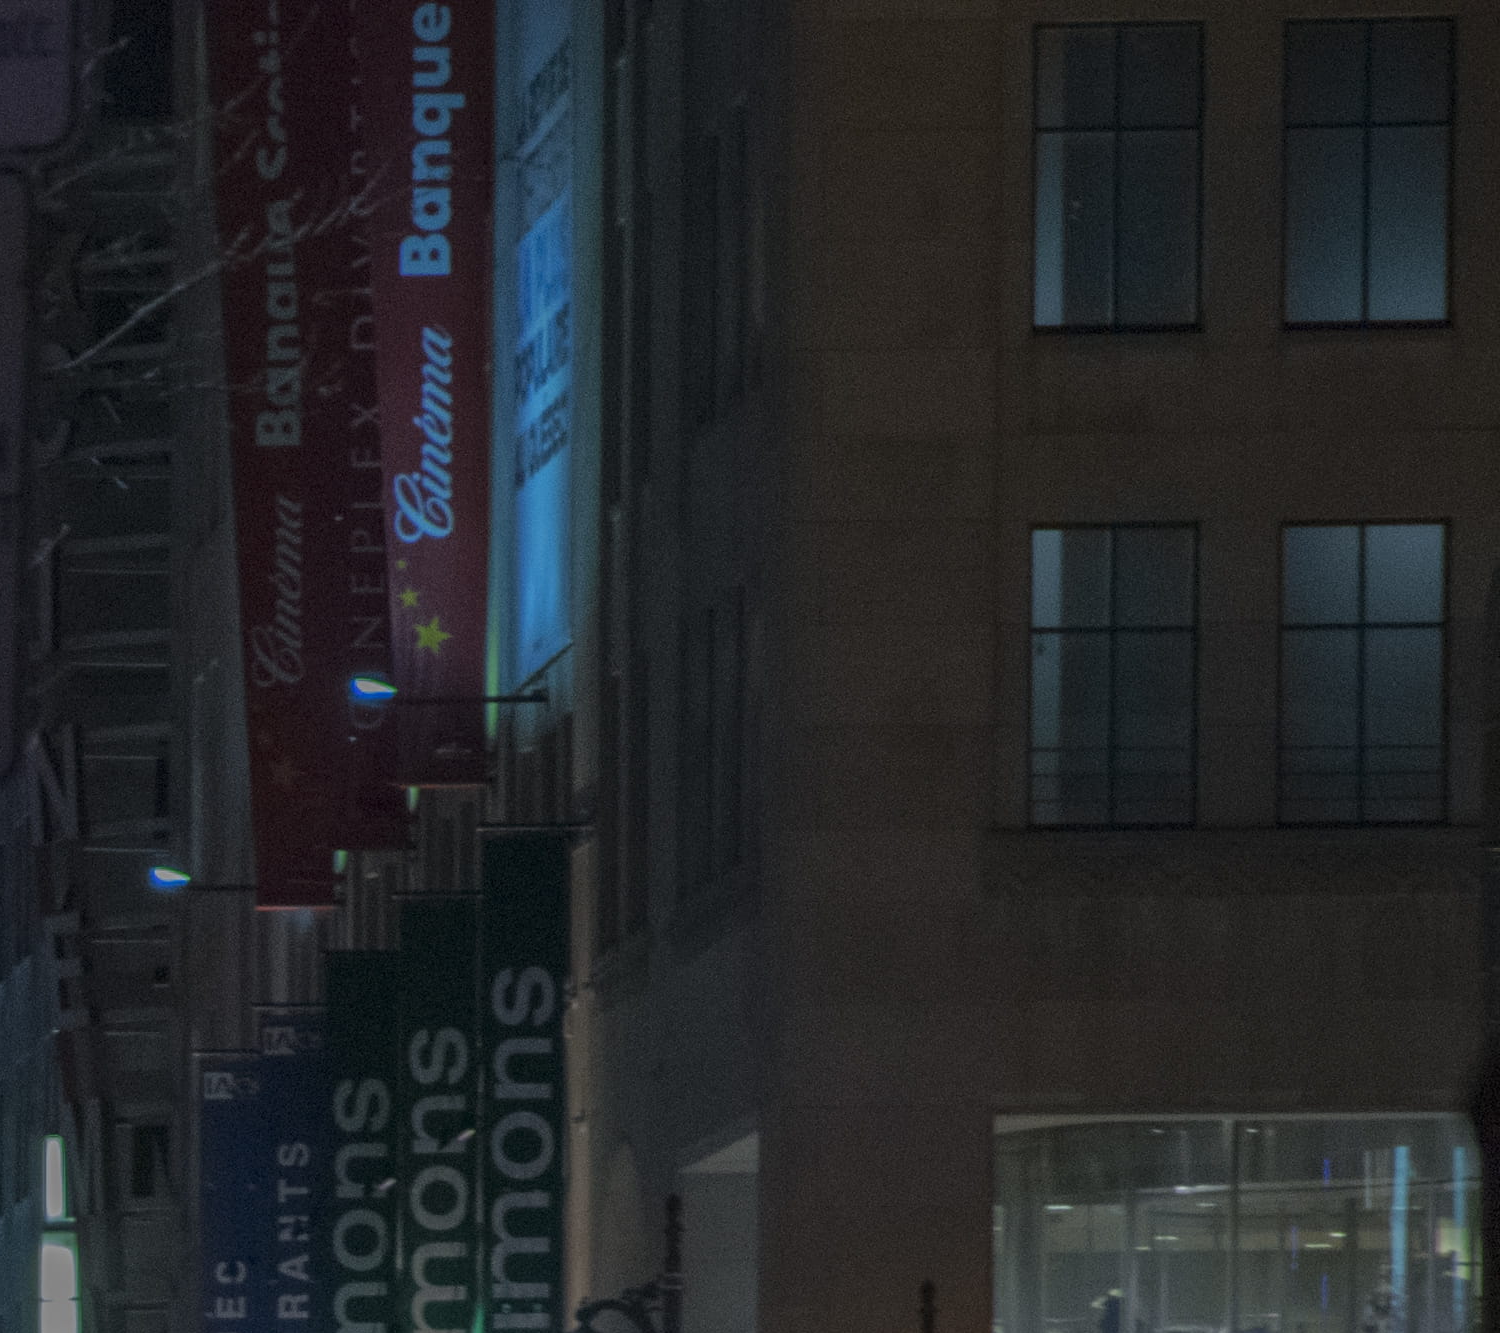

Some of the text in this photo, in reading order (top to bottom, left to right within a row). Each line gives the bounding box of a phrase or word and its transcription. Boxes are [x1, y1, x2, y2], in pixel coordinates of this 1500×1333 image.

[393, 2, 466, 543] Cinéma Banque
[251, 492, 304, 689] Cinéma
